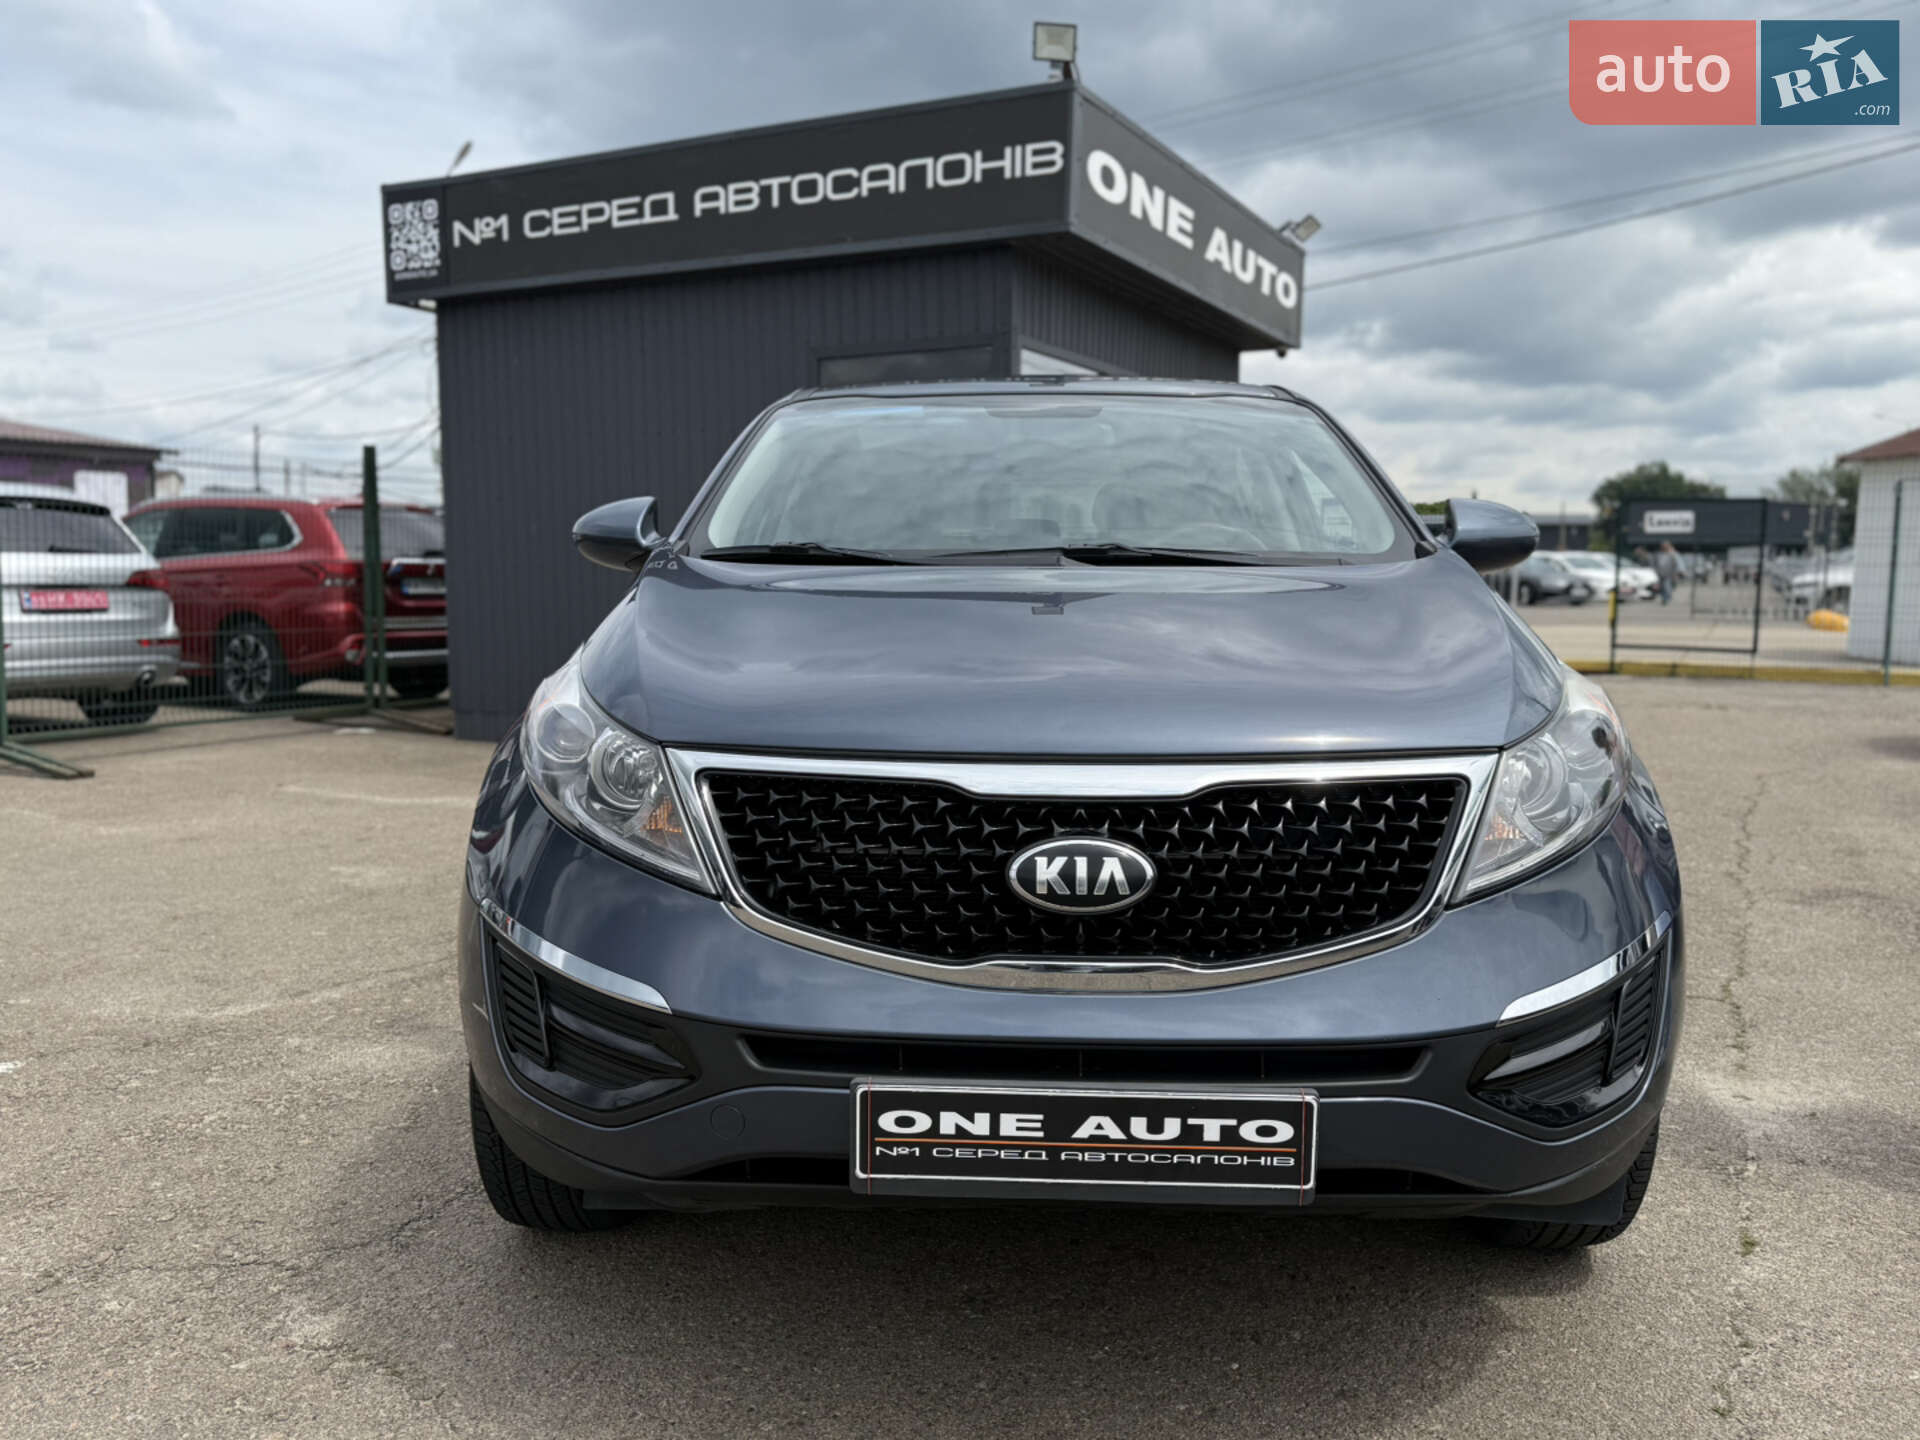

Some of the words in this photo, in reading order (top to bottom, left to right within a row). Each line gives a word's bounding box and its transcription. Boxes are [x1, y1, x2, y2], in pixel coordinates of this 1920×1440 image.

[452, 213, 509, 248] №1
[522, 190, 679, 239] СЕРЕД
[1086, 149, 1195, 250] ONE
[1203, 226, 1297, 309] AUTO
[1034, 856, 1131, 895] KIA
[876, 1109, 1045, 1138] ONE
[1070, 1115, 1296, 1144] AUTO
[931, 1147, 1049, 1161] СЕРЕД
